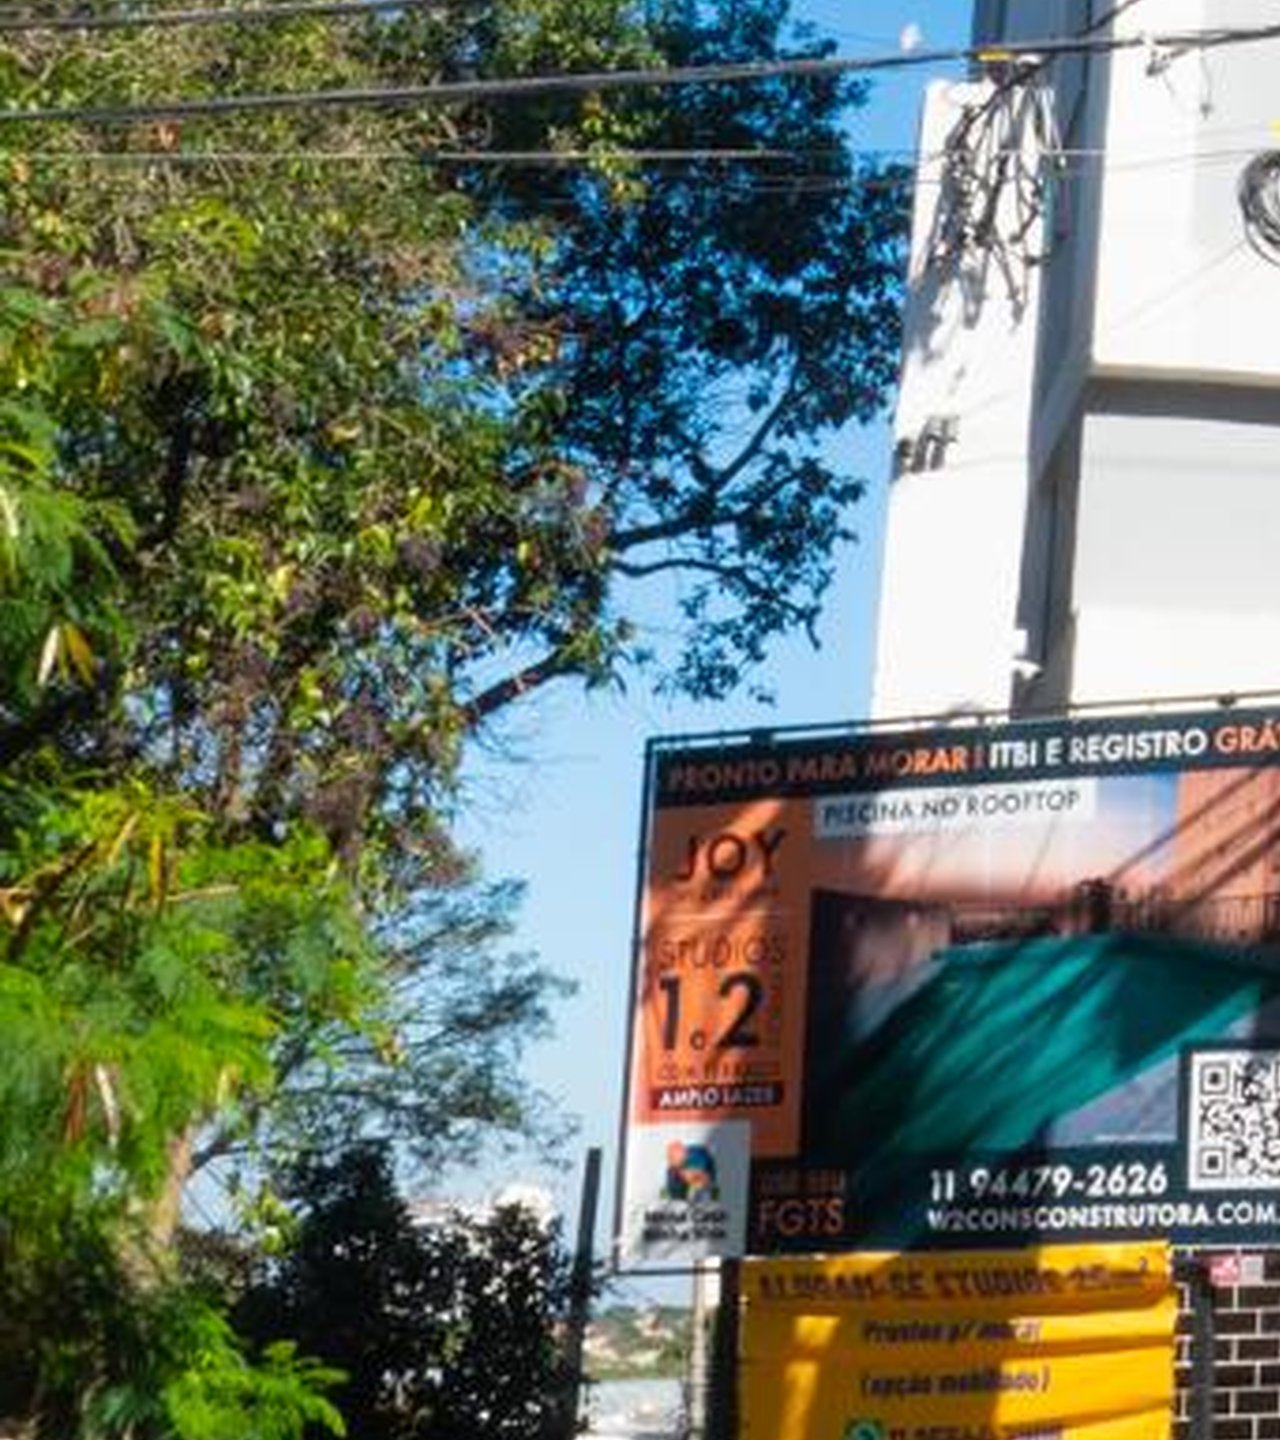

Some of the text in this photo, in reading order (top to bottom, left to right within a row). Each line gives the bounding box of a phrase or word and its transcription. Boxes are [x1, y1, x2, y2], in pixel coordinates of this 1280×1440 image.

[668, 759, 779, 791] PRONTO
[787, 754, 856, 782] PARA
[866, 746, 968, 777] MORAR
[989, 739, 1037, 768] ITBI
[1045, 738, 1063, 765] E
[1069, 729, 1208, 763] REGISTRO
[823, 789, 1081, 827] PISCINA NO ROOFTOP
[674, 829, 788, 883] JOY
[969, 1161, 1169, 1199] 94479-2626
